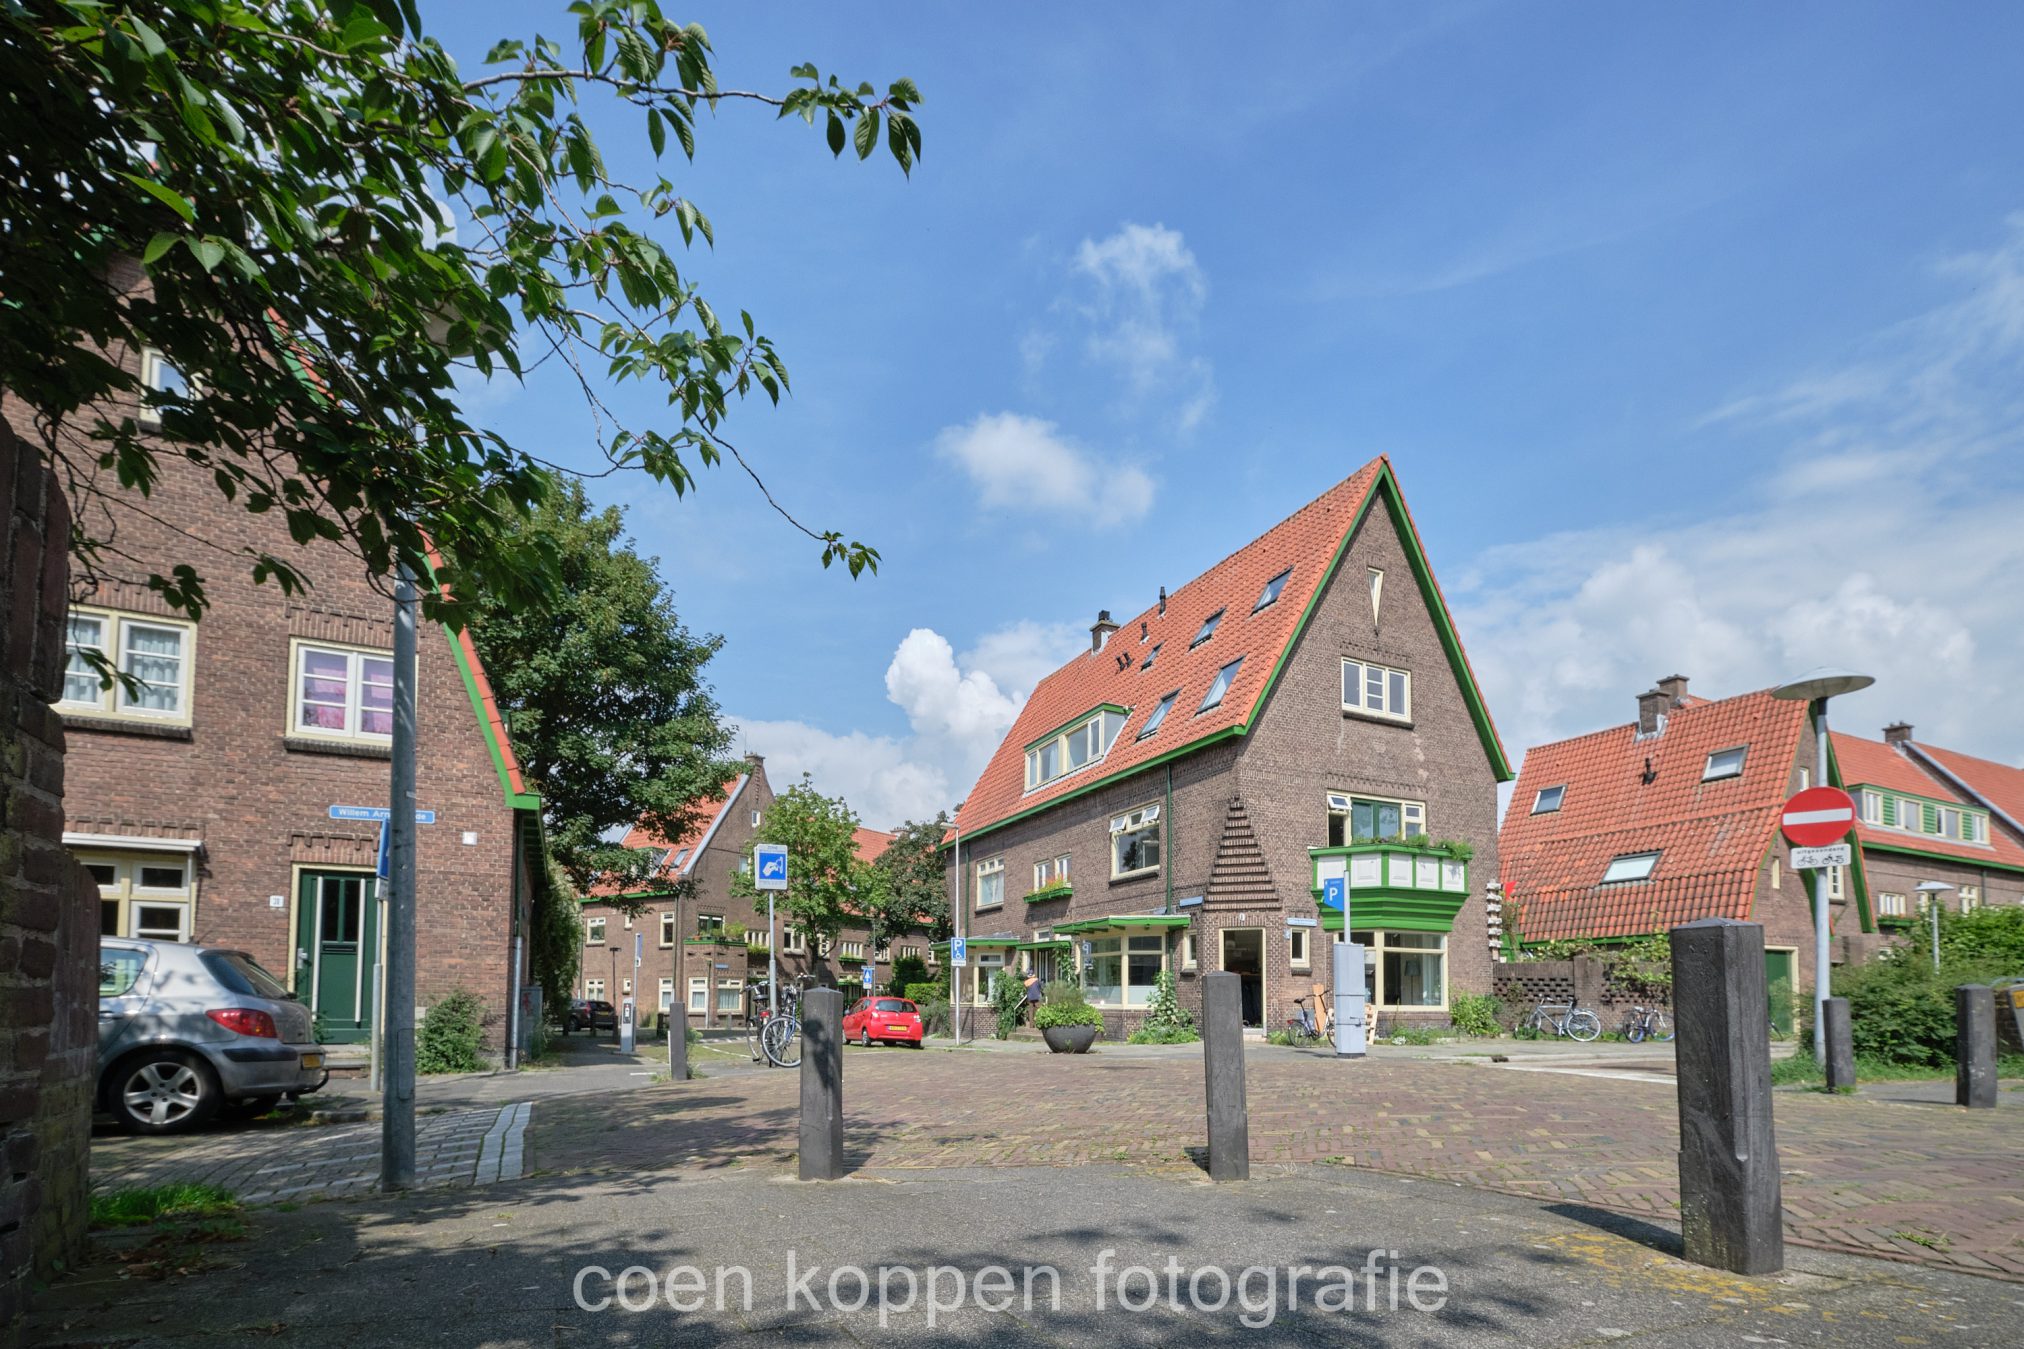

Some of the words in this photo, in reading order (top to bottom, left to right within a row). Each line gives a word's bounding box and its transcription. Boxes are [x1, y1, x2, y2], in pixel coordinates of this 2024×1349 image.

[338, 808, 369, 817] Willem
[1329, 887, 1338, 902] P
[954, 940, 962, 951] P
